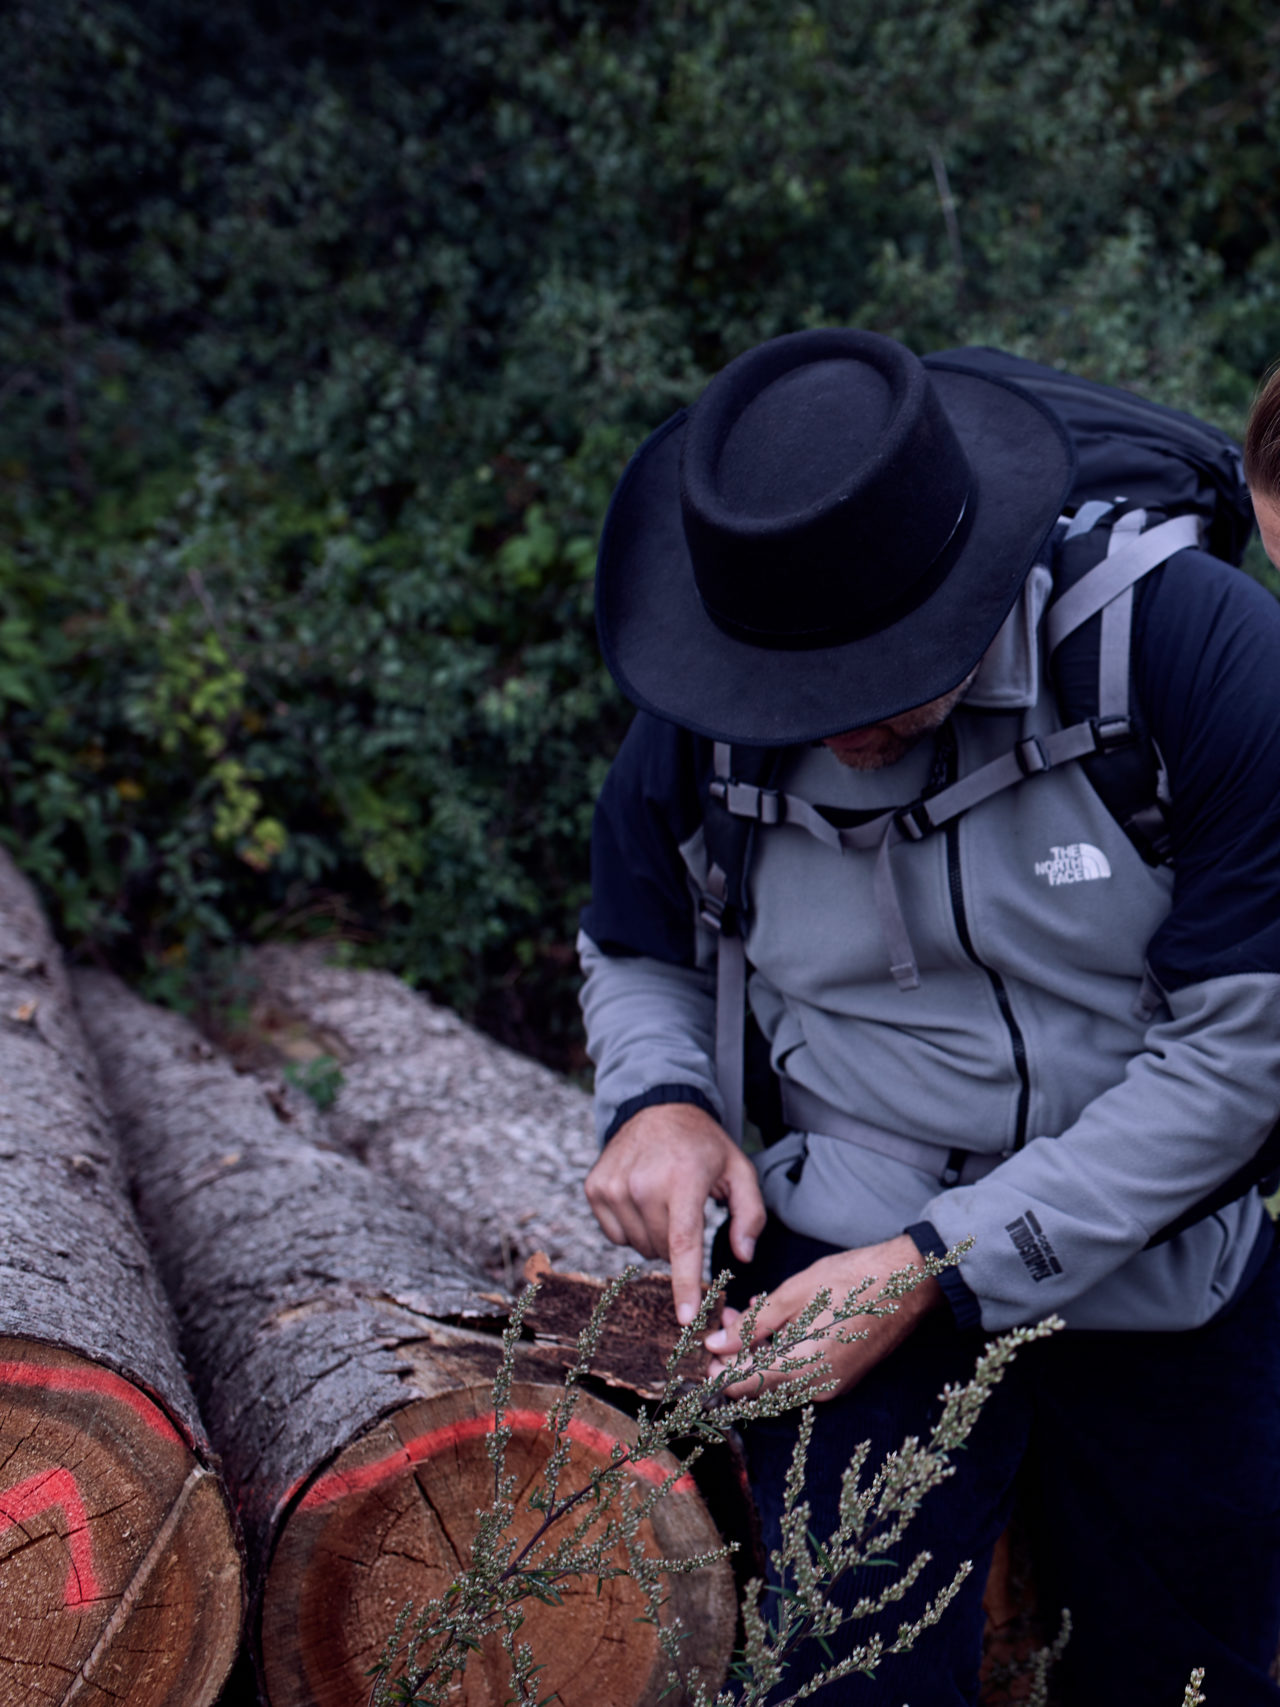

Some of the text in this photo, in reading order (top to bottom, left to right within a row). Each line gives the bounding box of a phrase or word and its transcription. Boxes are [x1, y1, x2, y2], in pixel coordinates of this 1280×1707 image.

[1050, 843, 1080, 860] THE
[1034, 854, 1082, 876] NORTH
[1048, 869, 1084, 886] FACE
